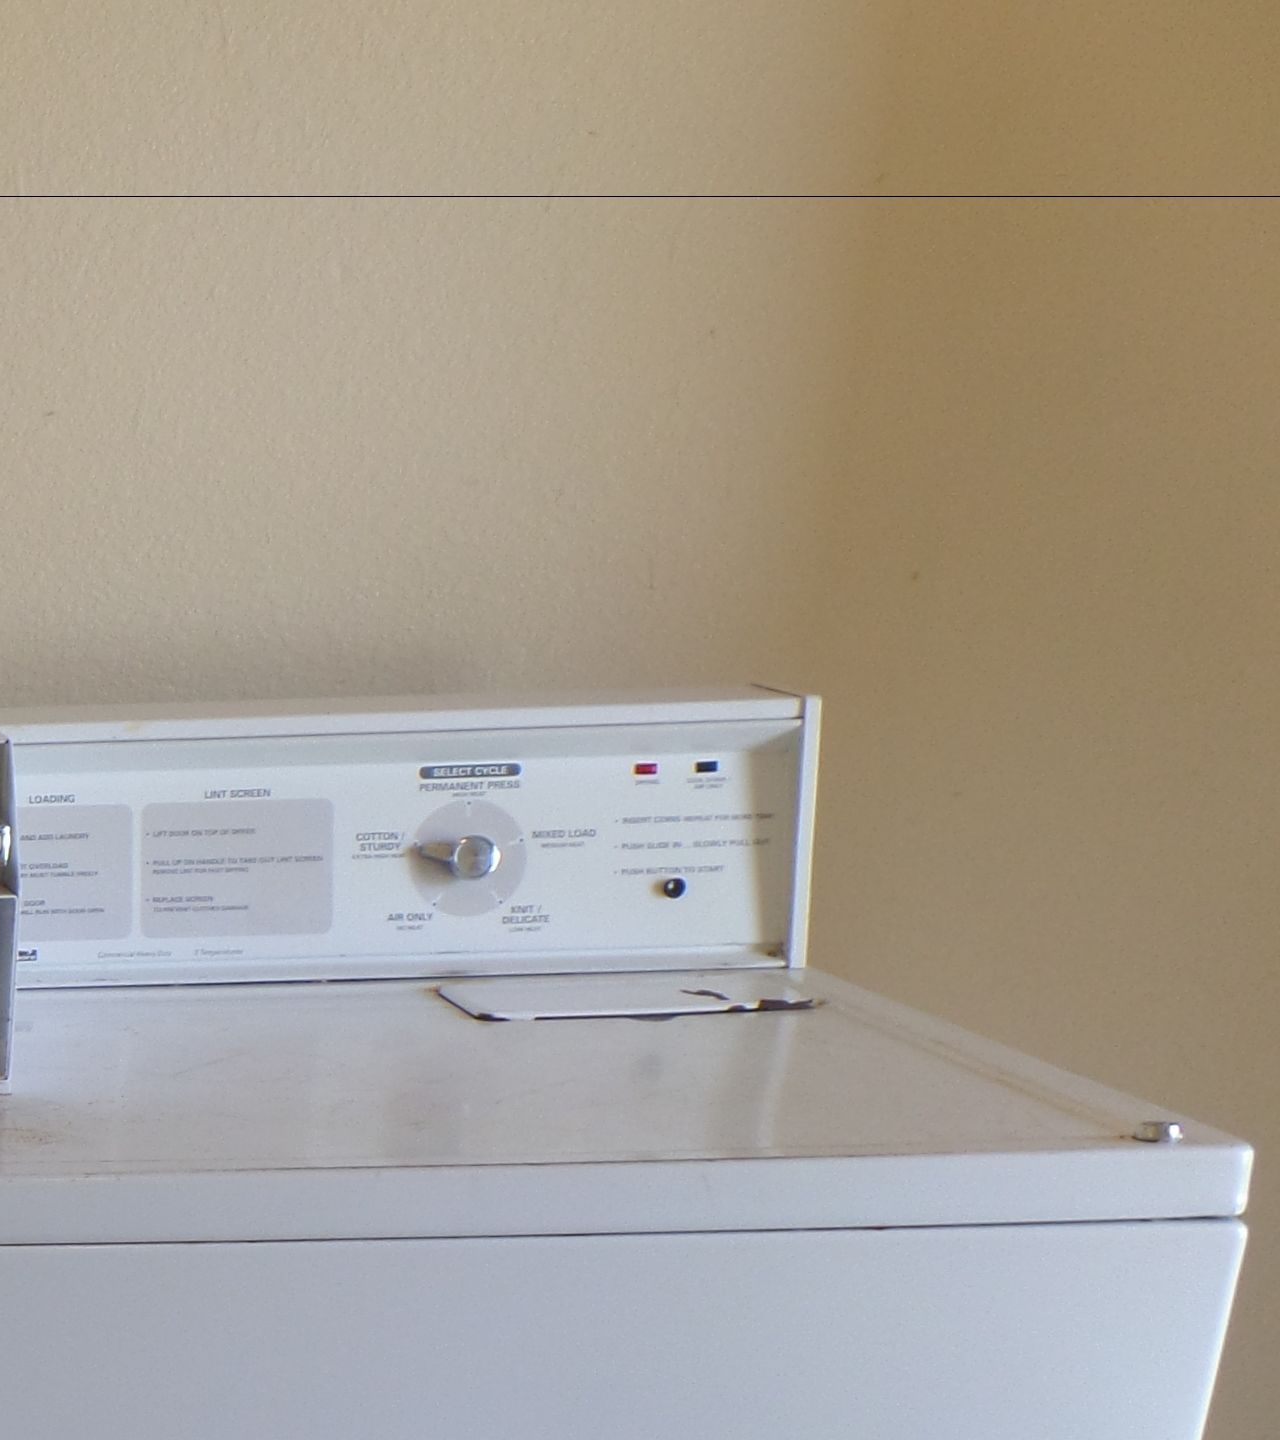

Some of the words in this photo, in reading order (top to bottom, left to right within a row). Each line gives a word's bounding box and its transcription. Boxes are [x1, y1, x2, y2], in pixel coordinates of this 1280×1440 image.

[433, 767, 472, 777] SELECT
[474, 766, 508, 776] CYCLE
[419, 781, 484, 792] PERMANENT
[486, 780, 520, 789] PRESS
[203, 789, 227, 799] LINT
[230, 788, 271, 798] SCREEN
[28, 794, 76, 804] LOADING
[355, 831, 400, 841] COTTON
[530, 830, 565, 839] MIXED
[567, 828, 597, 838] LOAD
[360, 841, 402, 851] STURDY
[510, 905, 534, 914] KNIT
[387, 913, 404, 921] AIR
[406, 912, 433, 921] ONLY
[502, 915, 550, 924] DELICATE
